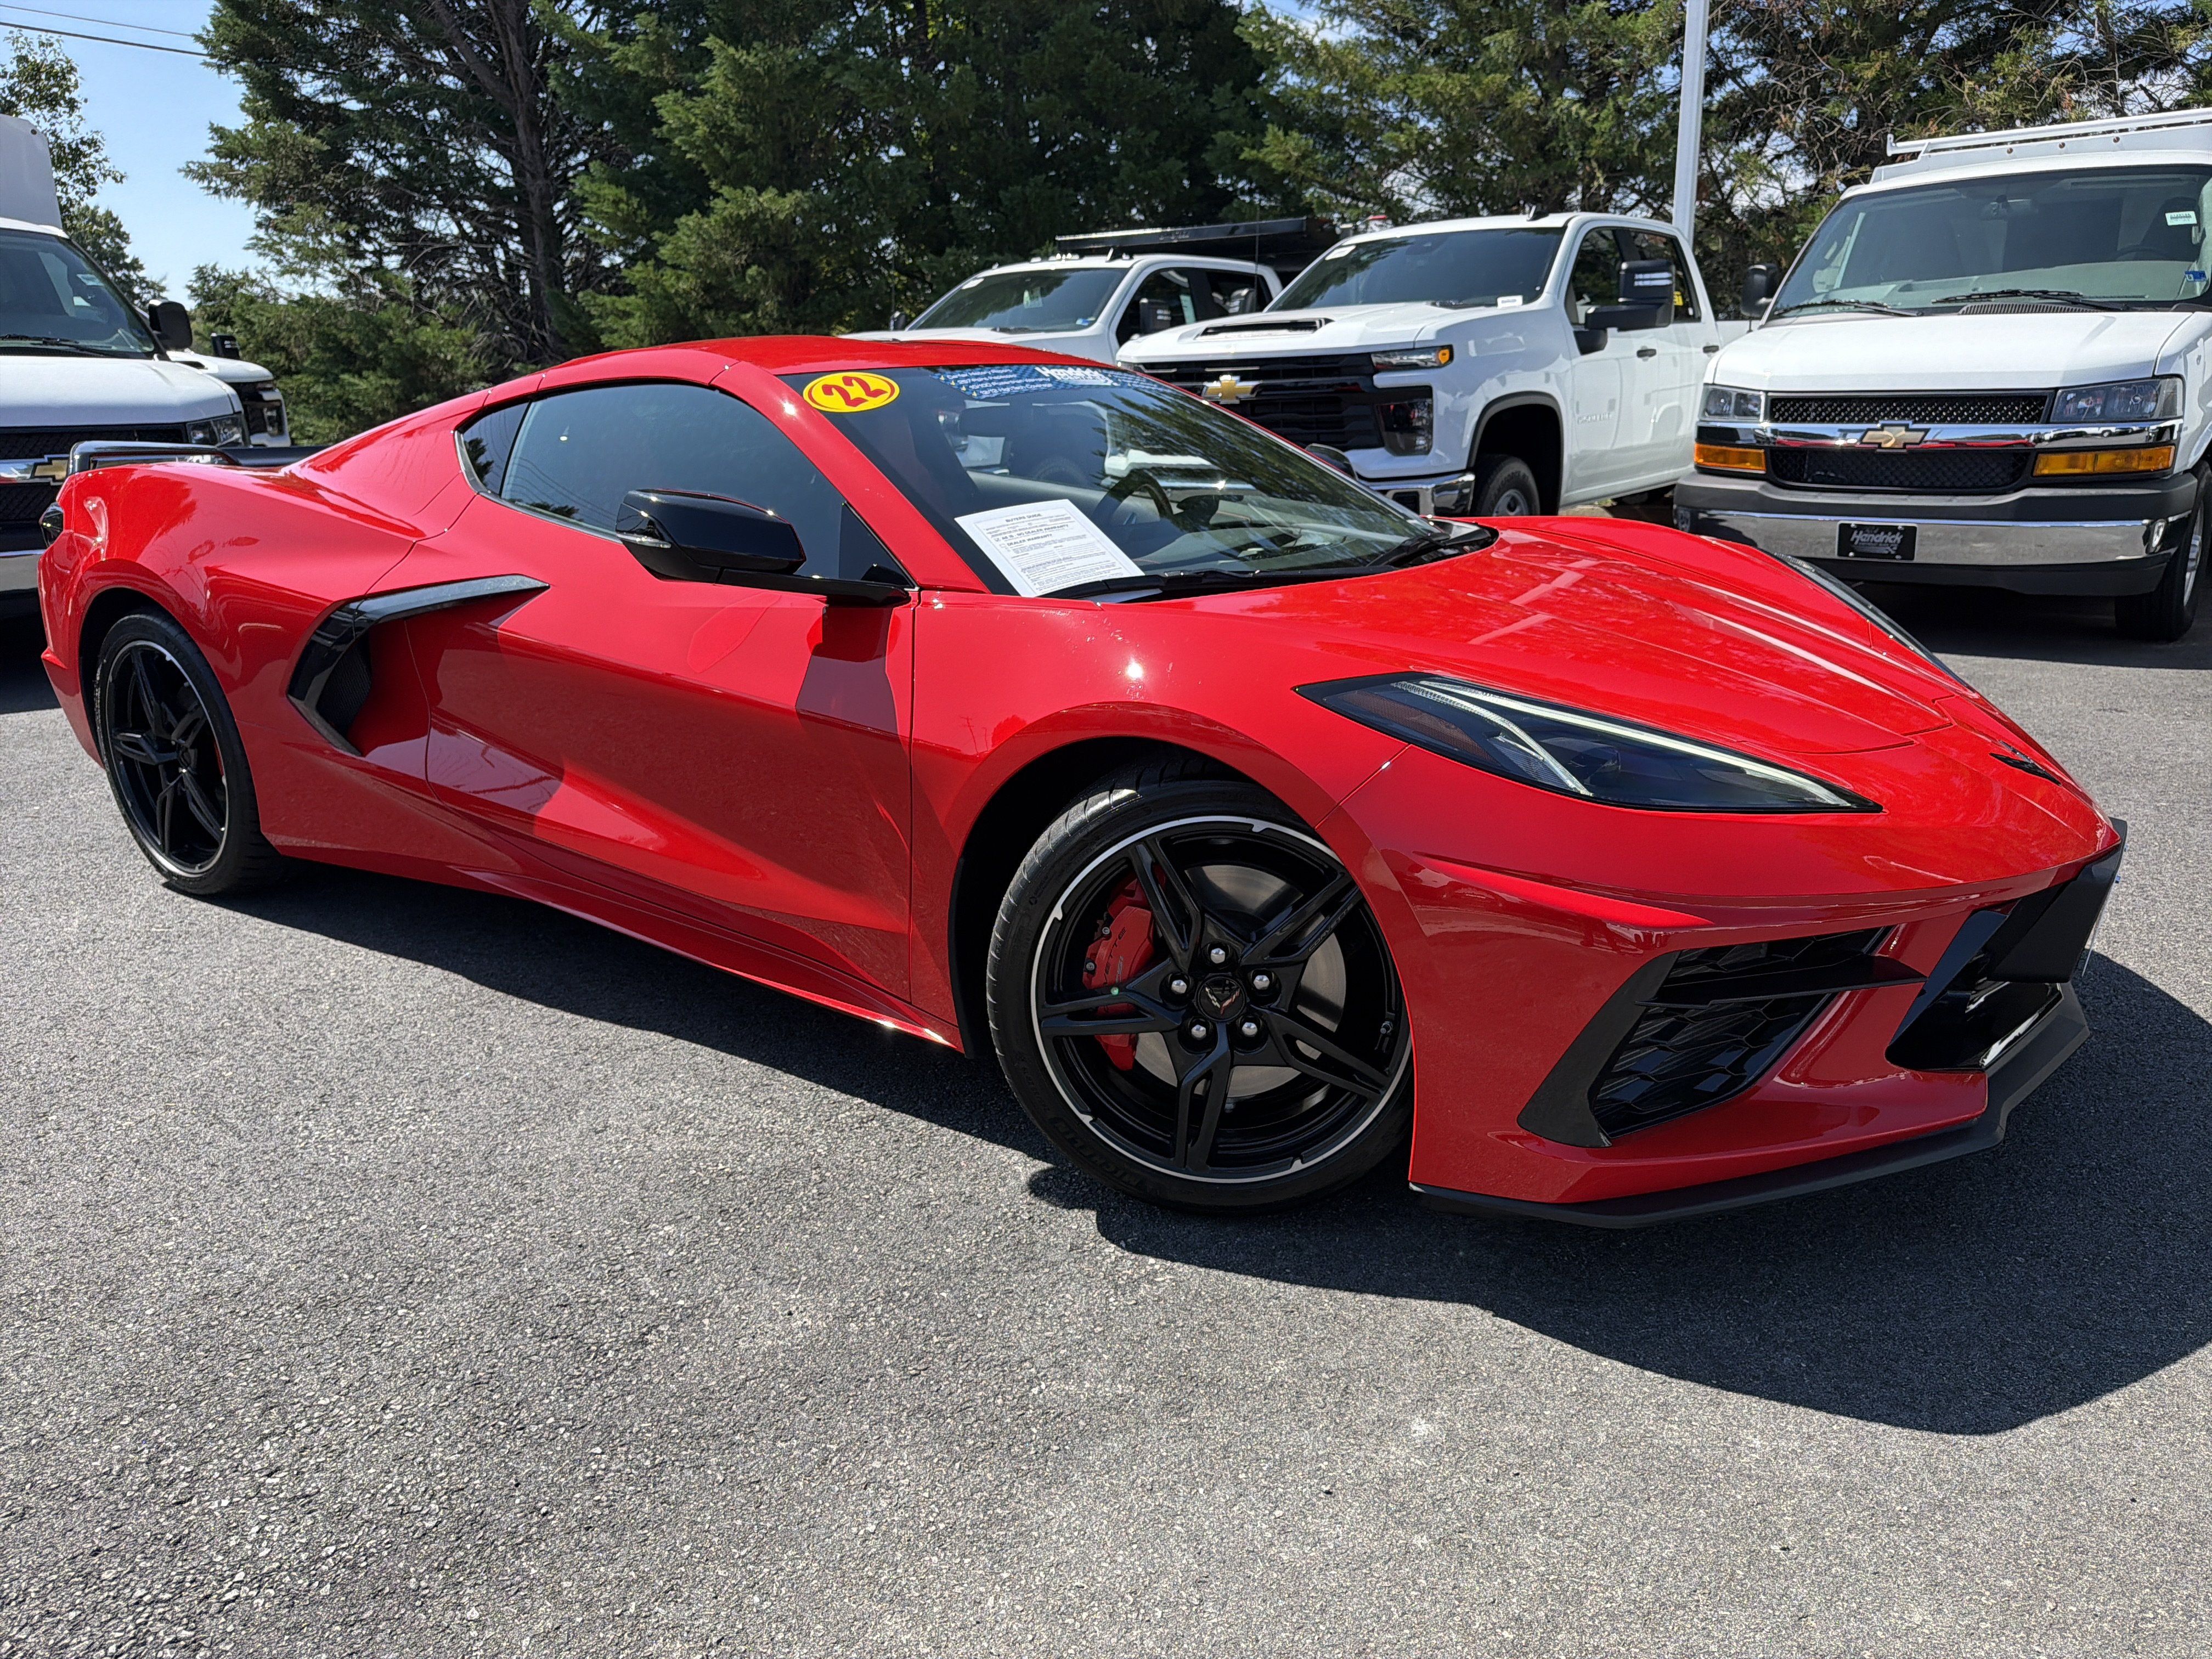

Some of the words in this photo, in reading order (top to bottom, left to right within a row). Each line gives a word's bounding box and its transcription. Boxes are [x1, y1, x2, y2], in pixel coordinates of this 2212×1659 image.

[1034, 366, 1104, 380] Hendrick
[822, 376, 888, 407] 22
[1850, 529, 1904, 545] Hendrick
